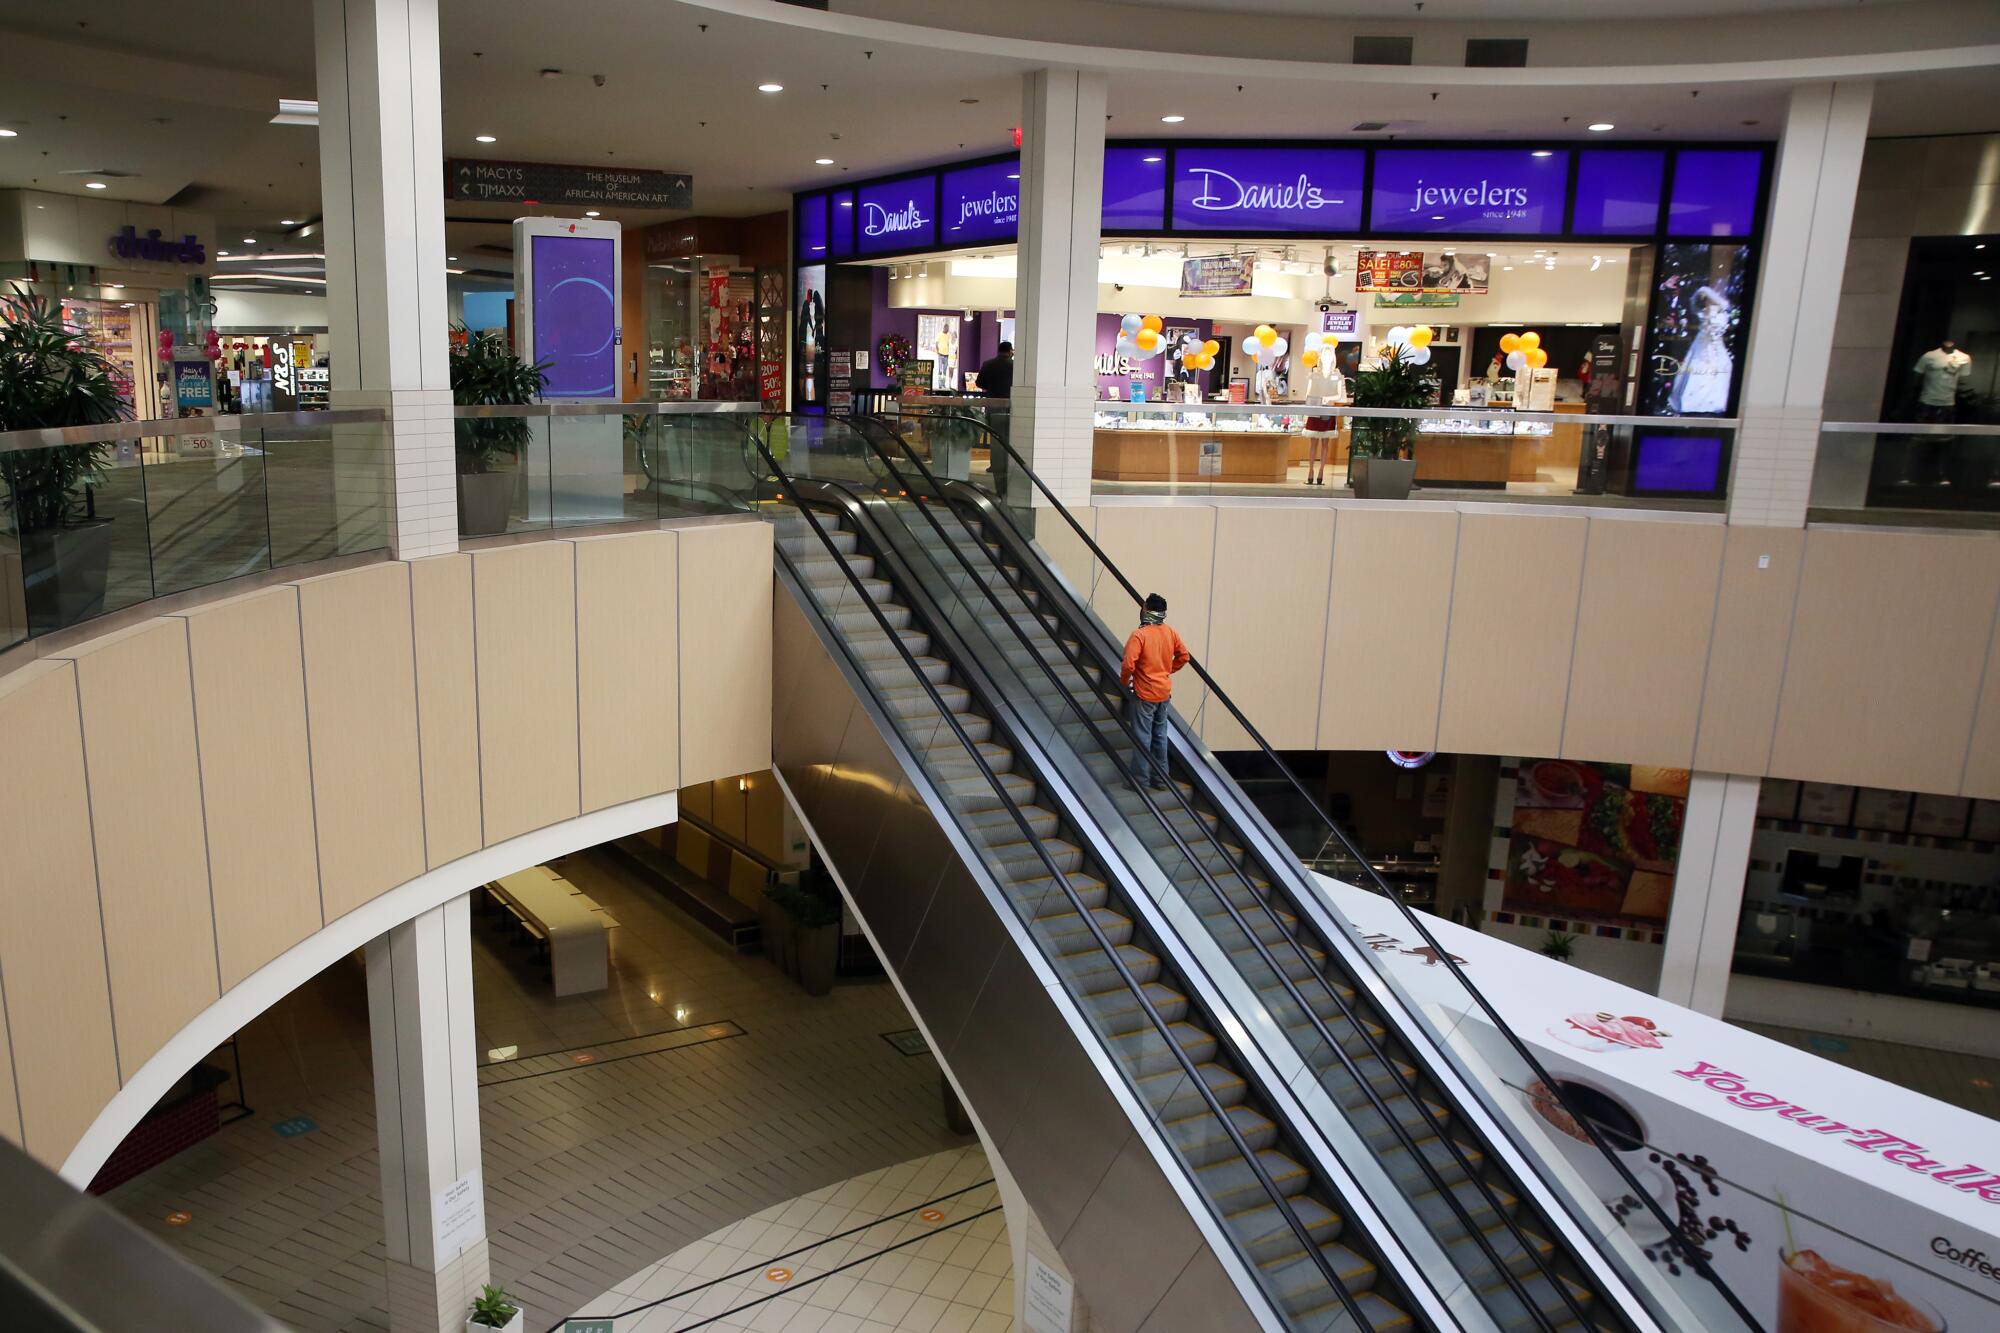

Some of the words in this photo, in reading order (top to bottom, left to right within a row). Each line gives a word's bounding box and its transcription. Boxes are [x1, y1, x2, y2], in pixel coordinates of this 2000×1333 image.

[476, 166, 523, 180] MACY'S
[585, 172, 602, 182] THE
[605, 174, 641, 183] MUSEUM
[477, 183, 526, 198] TJMAXX
[606, 183, 619, 191] OF
[1188, 168, 1345, 210] Daniel's
[564, 190, 604, 200] AFRICAN
[605, 192, 650, 202] AMERICAN
[650, 194, 670, 203] ART
[1410, 180, 1528, 213] jewelers
[958, 190, 1017, 224] jewelers
[1482, 209, 1504, 218] since
[1506, 209, 1527, 218] 1948
[863, 200, 930, 235] Daniel's
[1359, 259, 1391, 269] SALE!
[178, 387, 210, 398] FREE
[1931, 1236, 2000, 1280] Coffee
